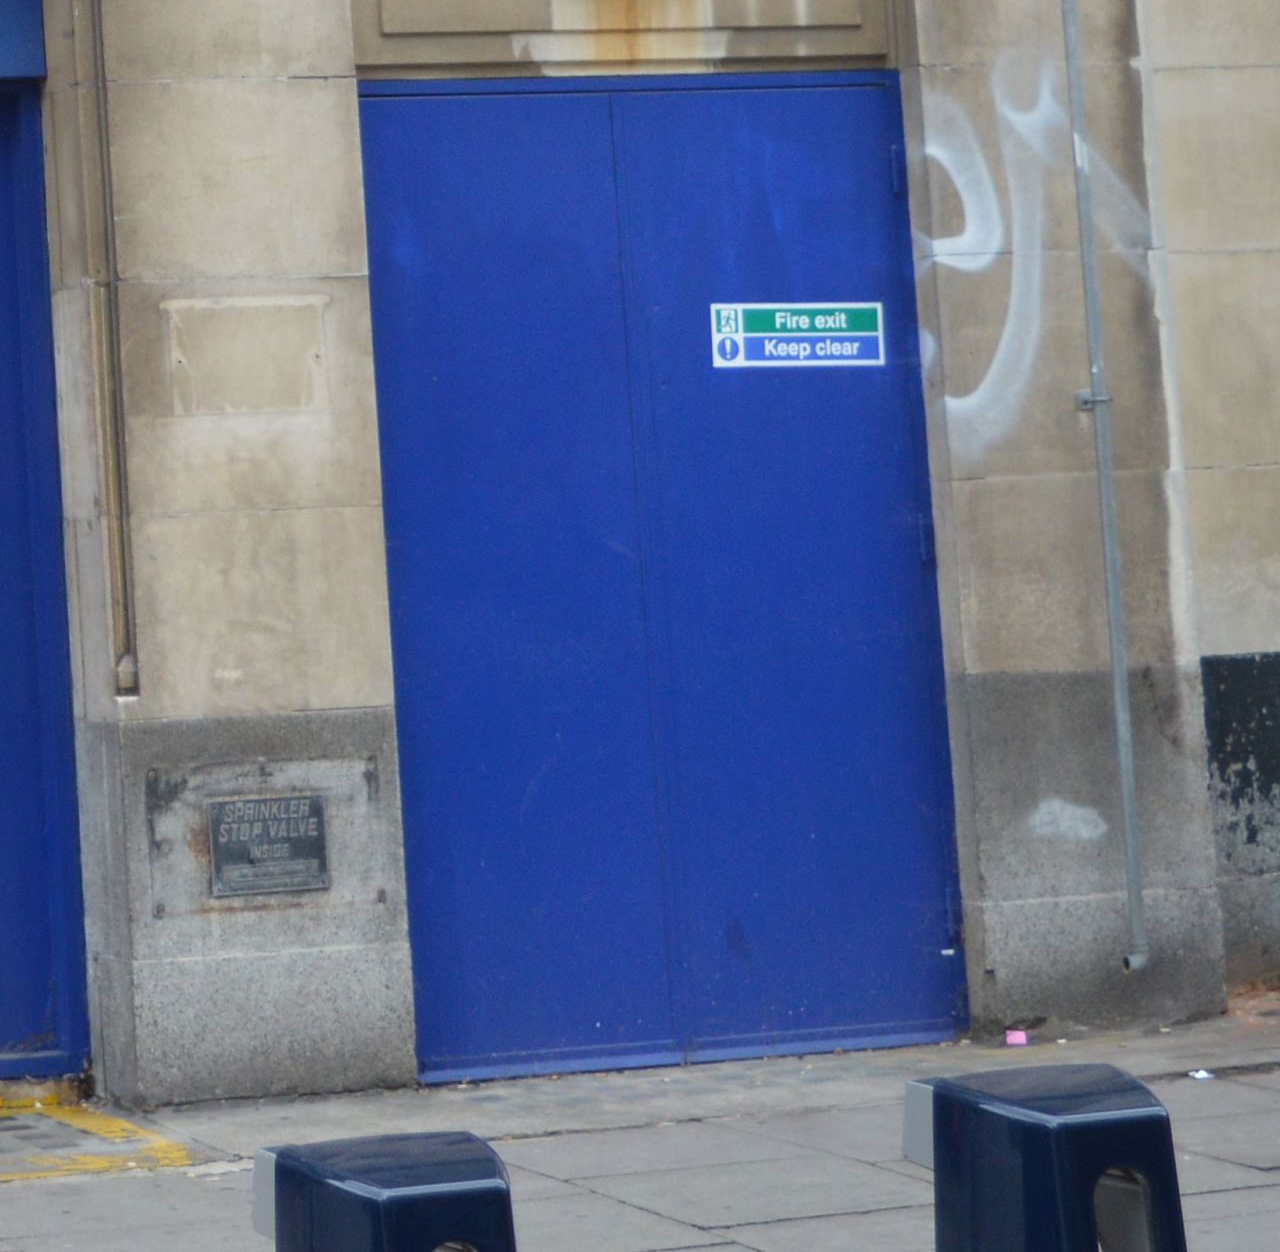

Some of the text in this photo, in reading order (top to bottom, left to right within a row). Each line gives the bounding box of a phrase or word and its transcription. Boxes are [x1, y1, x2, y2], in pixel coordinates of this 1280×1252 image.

[775, 312, 847, 329] Fire exit
[764, 338, 860, 359] Keep clear
[223, 799, 310, 822] SPRINKLER
[218, 817, 318, 843] STOP VALVE
[250, 843, 290, 859] INSIDE
